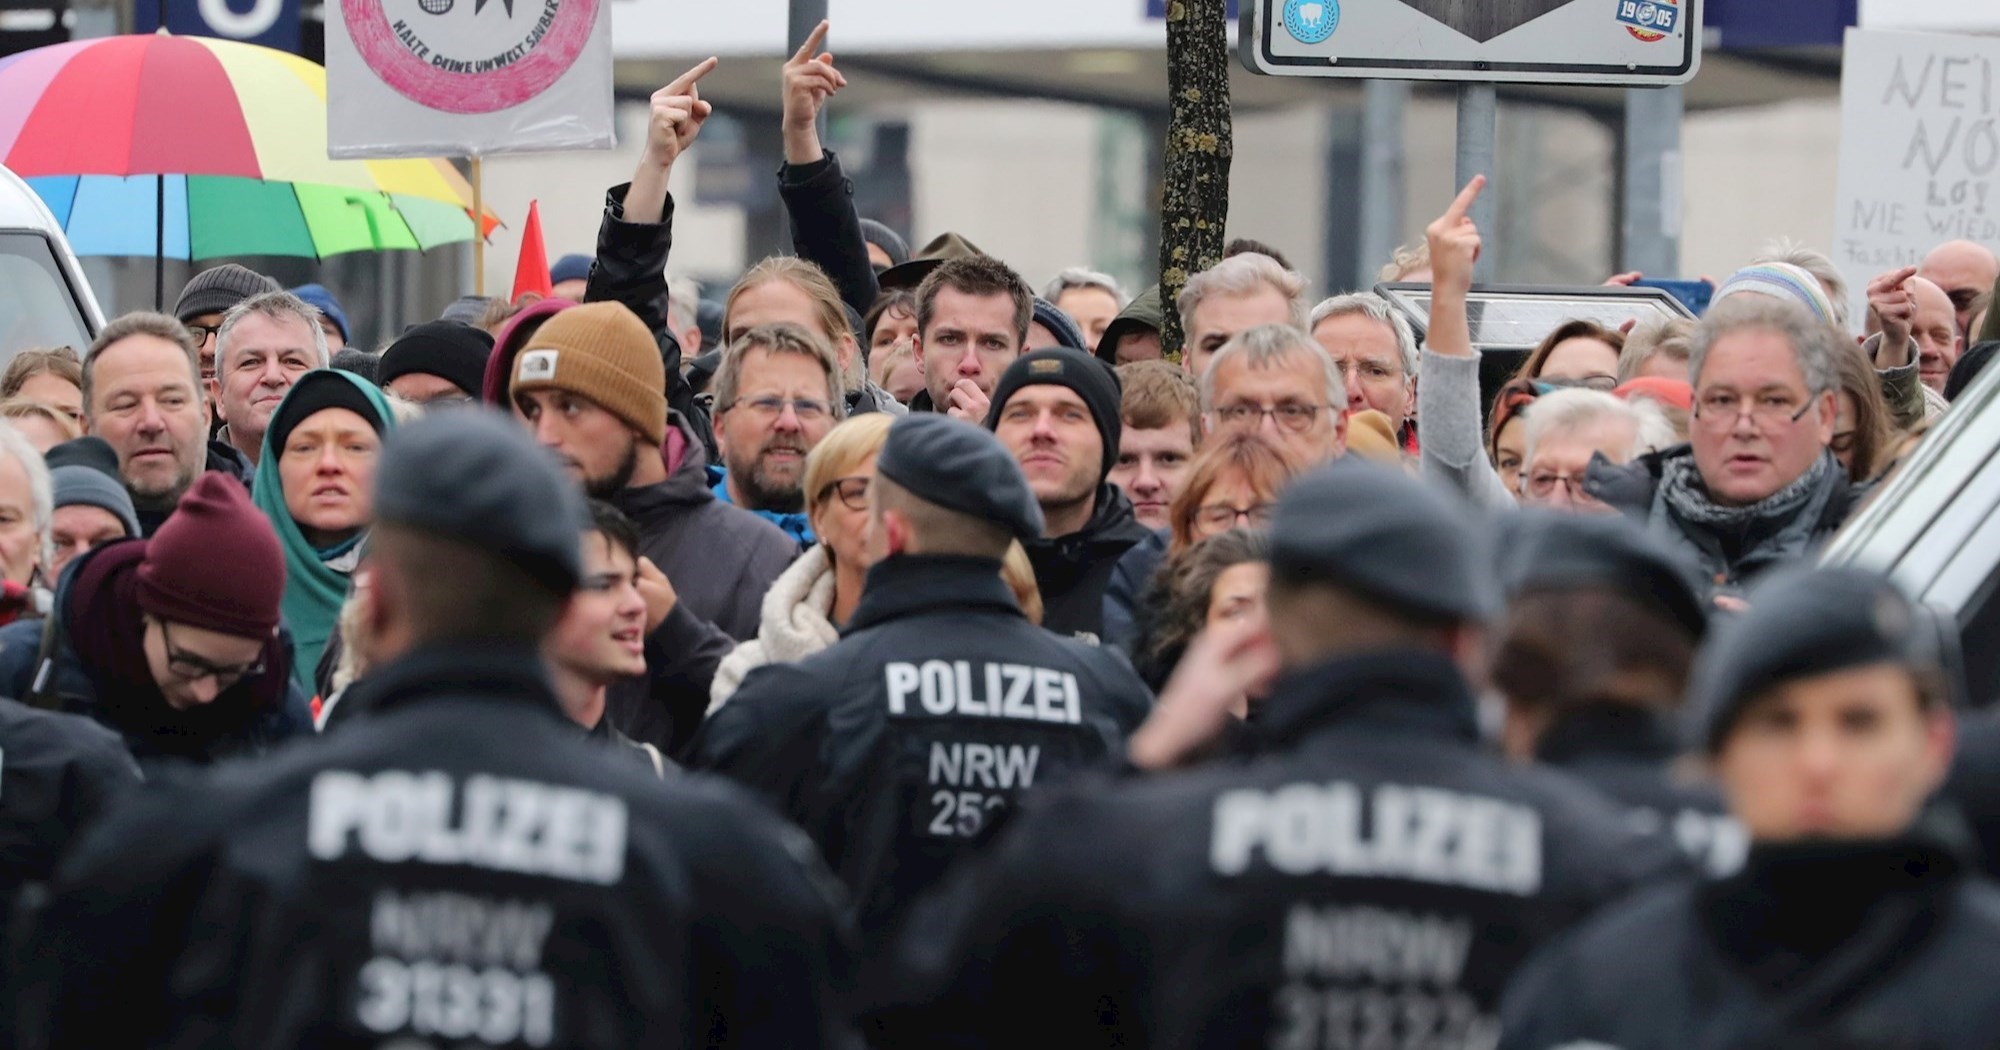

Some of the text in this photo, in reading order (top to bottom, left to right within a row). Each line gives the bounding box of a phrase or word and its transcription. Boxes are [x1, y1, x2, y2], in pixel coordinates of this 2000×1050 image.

[393, 19, 430, 58] HALTE
[432, 54, 473, 74] DEINE
[1882, 52, 2000, 115] NEI
[1851, 198, 1905, 236] NIE
[885, 659, 1082, 724] POLIZEI
[928, 741, 1040, 789] NRW
[308, 768, 628, 886] POLIZEI
[1210, 780, 1542, 897] POLIZEI
